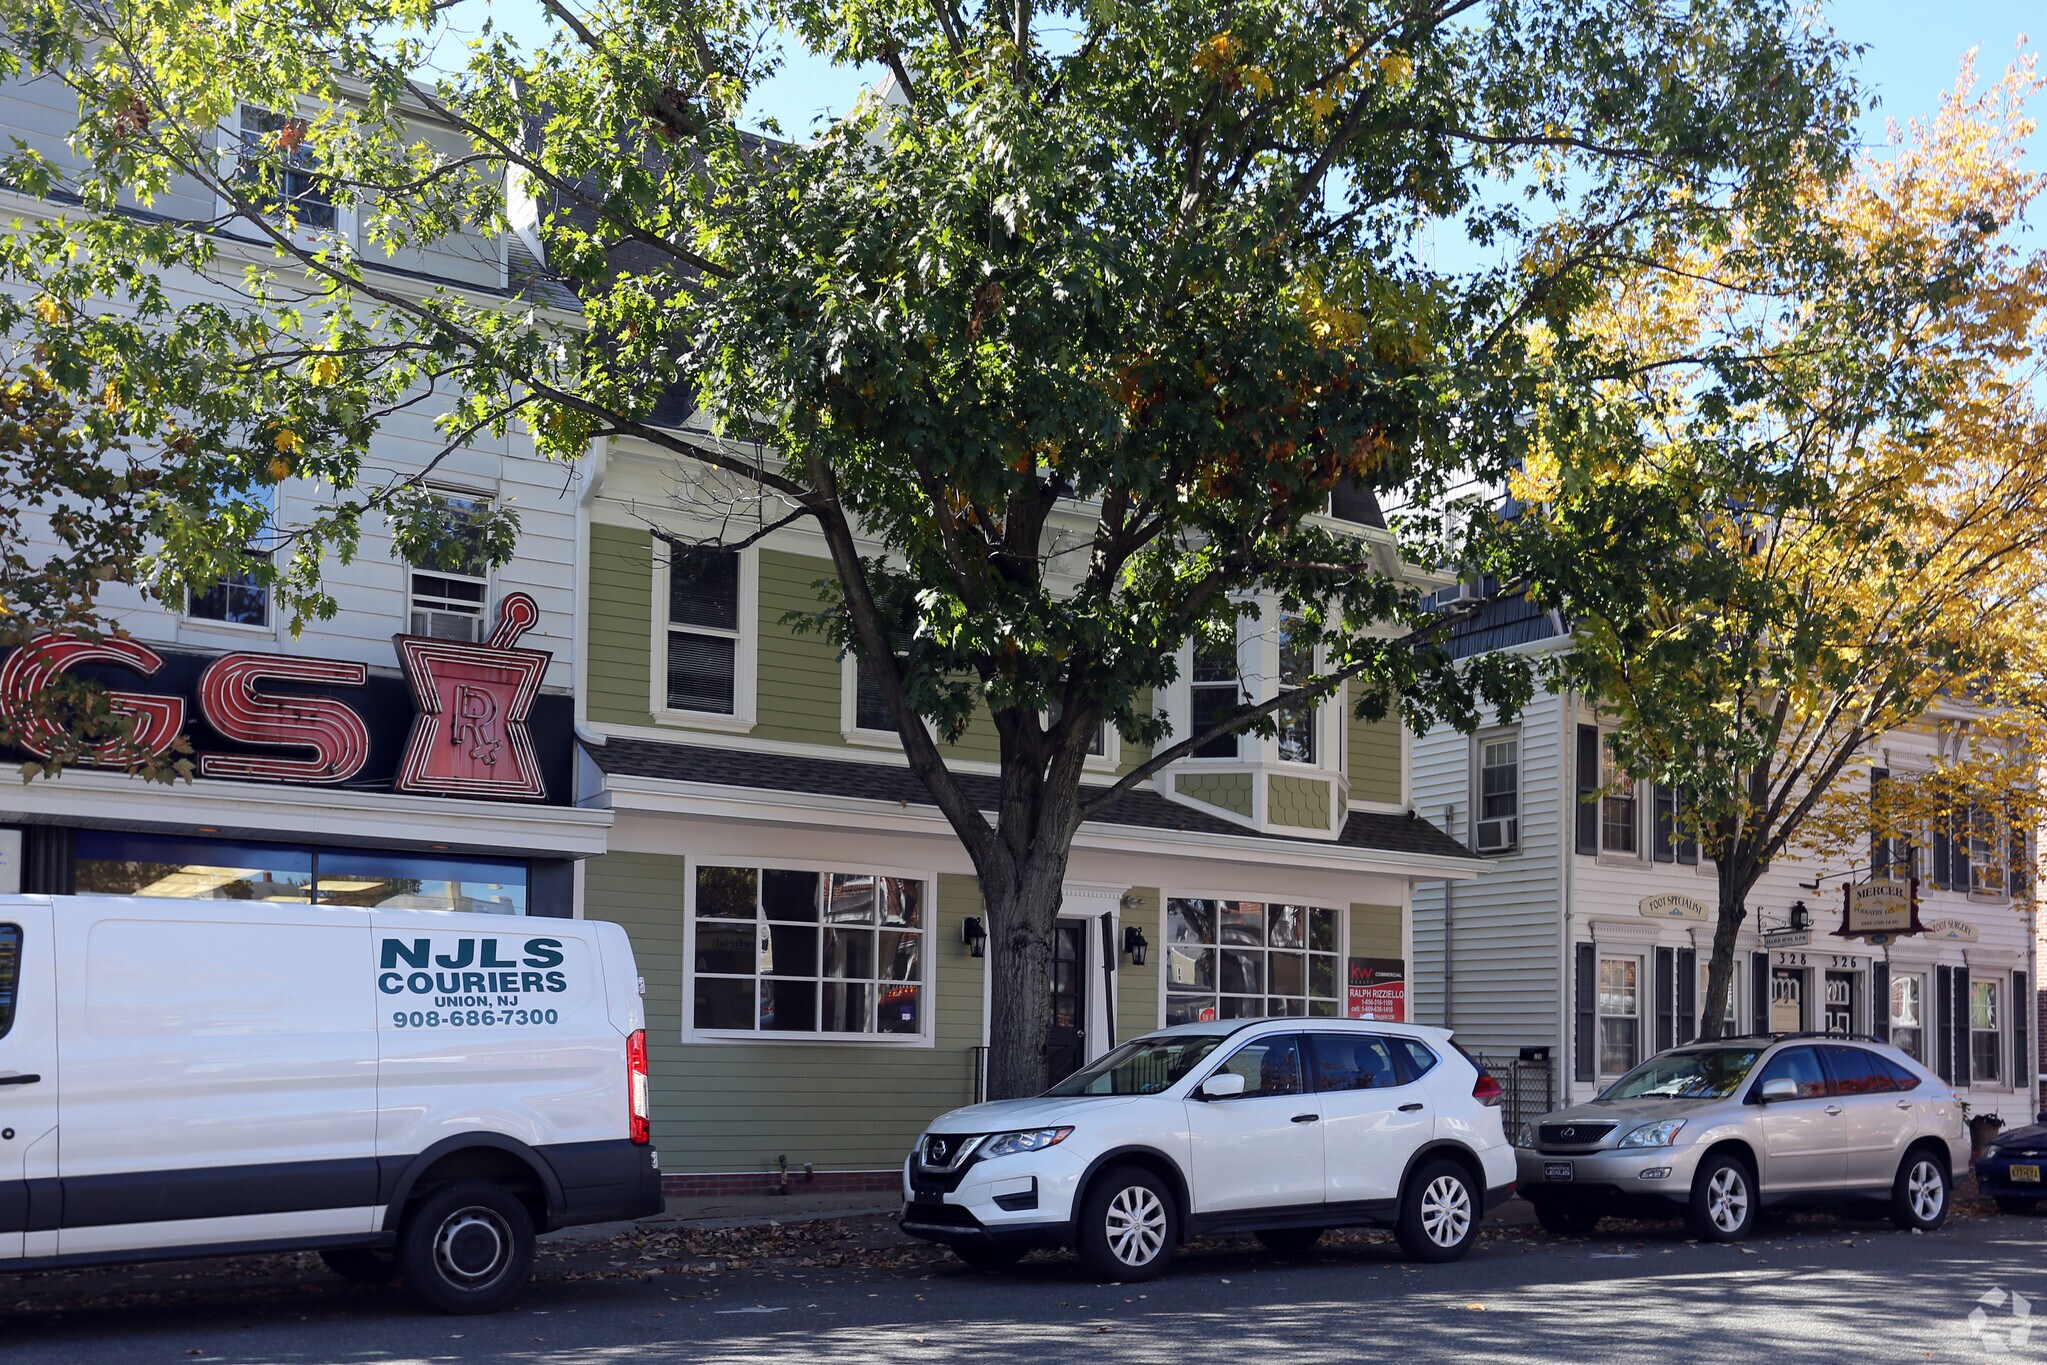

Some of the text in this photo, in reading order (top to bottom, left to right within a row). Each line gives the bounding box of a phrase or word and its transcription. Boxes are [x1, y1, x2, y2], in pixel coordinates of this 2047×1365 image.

[1856, 886, 1903, 900] MERCER
[1649, 896, 1702, 915] FOOT SPECIALIST
[380, 938, 564, 969] NJLS
[1780, 952, 1806, 965] 328
[1832, 955, 1856, 968] 326
[378, 971, 567, 994] COURIERS
[1350, 989, 1404, 999] RALPH RIZZIELLO
[434, 995, 518, 1008] UNION, NJ
[393, 1009, 559, 1028] 908-686-7300
